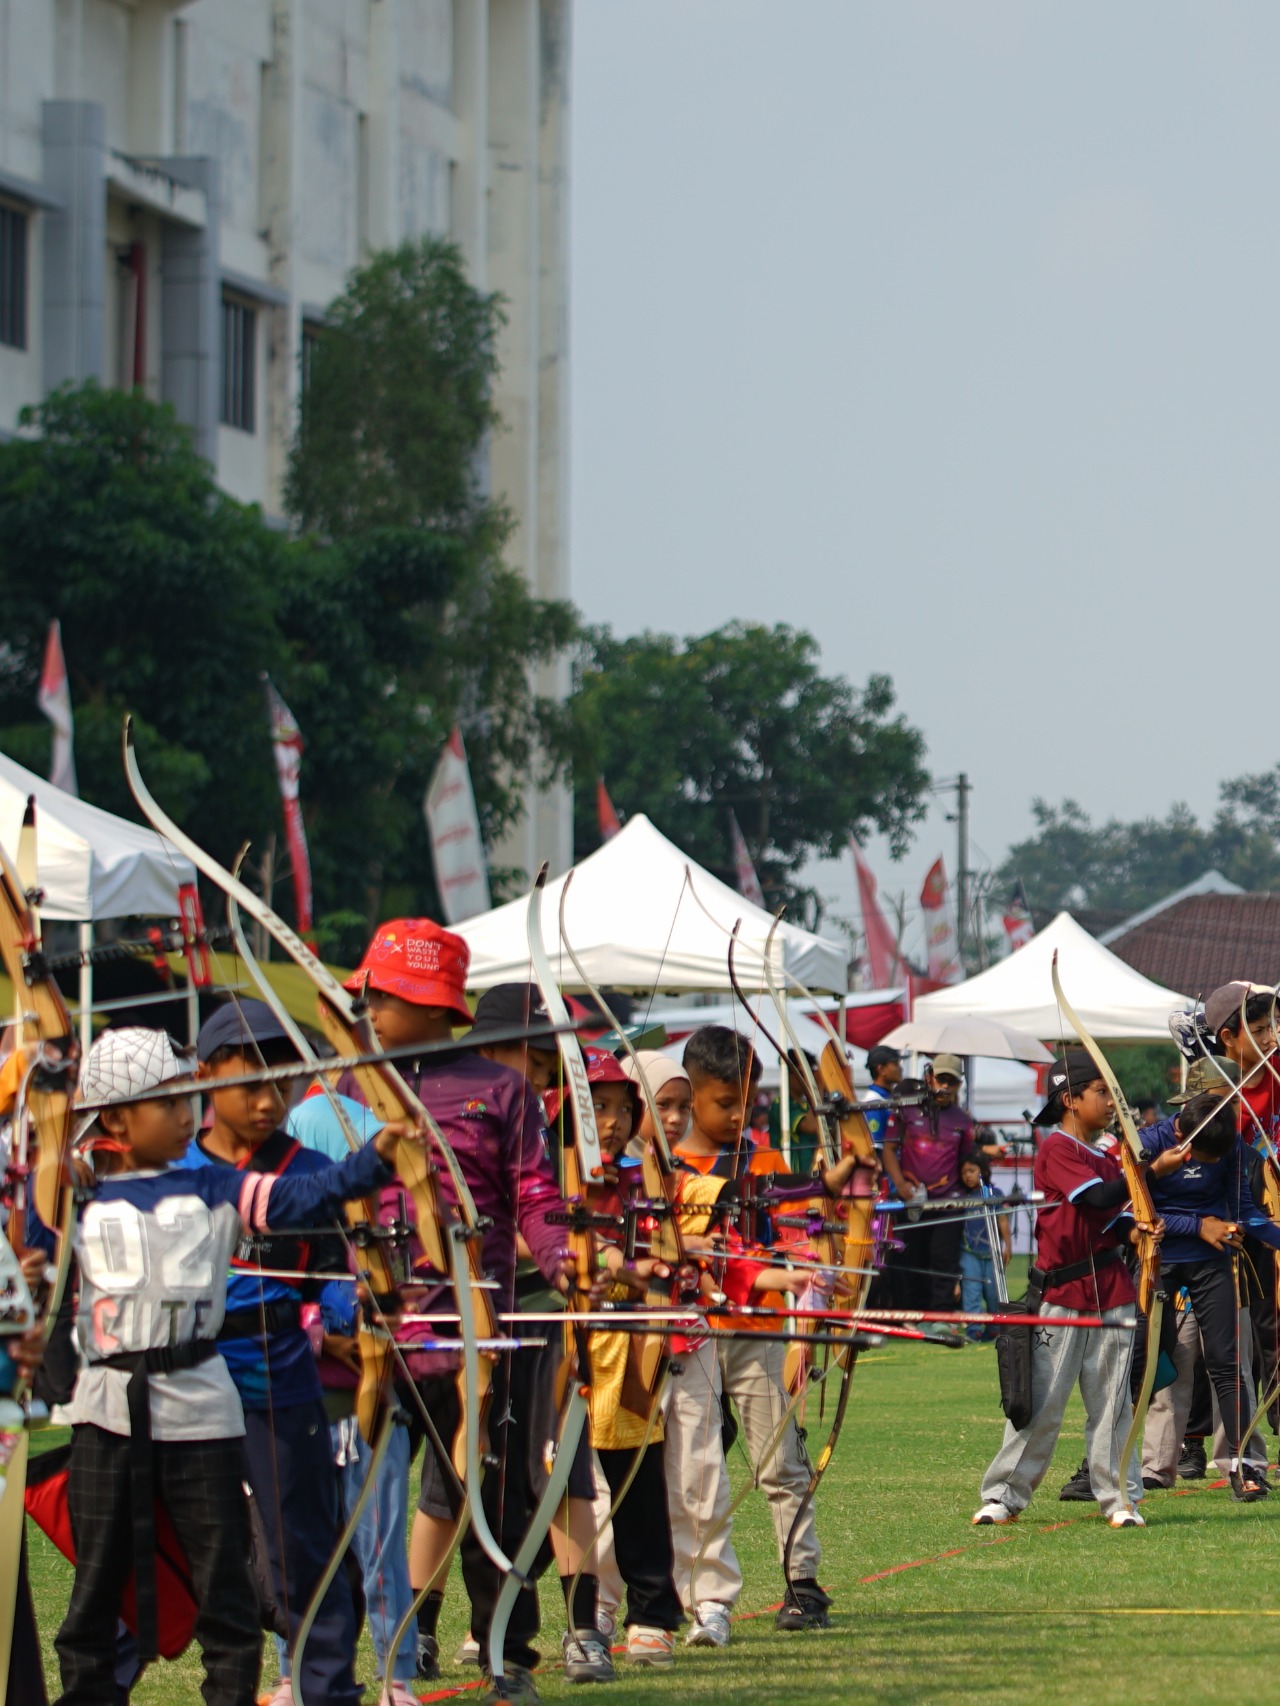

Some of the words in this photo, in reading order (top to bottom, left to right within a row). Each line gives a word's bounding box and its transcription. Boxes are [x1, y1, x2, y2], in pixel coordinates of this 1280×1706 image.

[407, 938, 442, 950] DON'T
[407, 946, 439, 956] WASTE
[407, 954, 440, 963] YOUR
[407, 961, 440, 971] YOUNG
[568, 1052, 597, 1147] CARTEL
[83, 1194, 217, 1294] 02
[93, 1298, 213, 1351] CUTE
